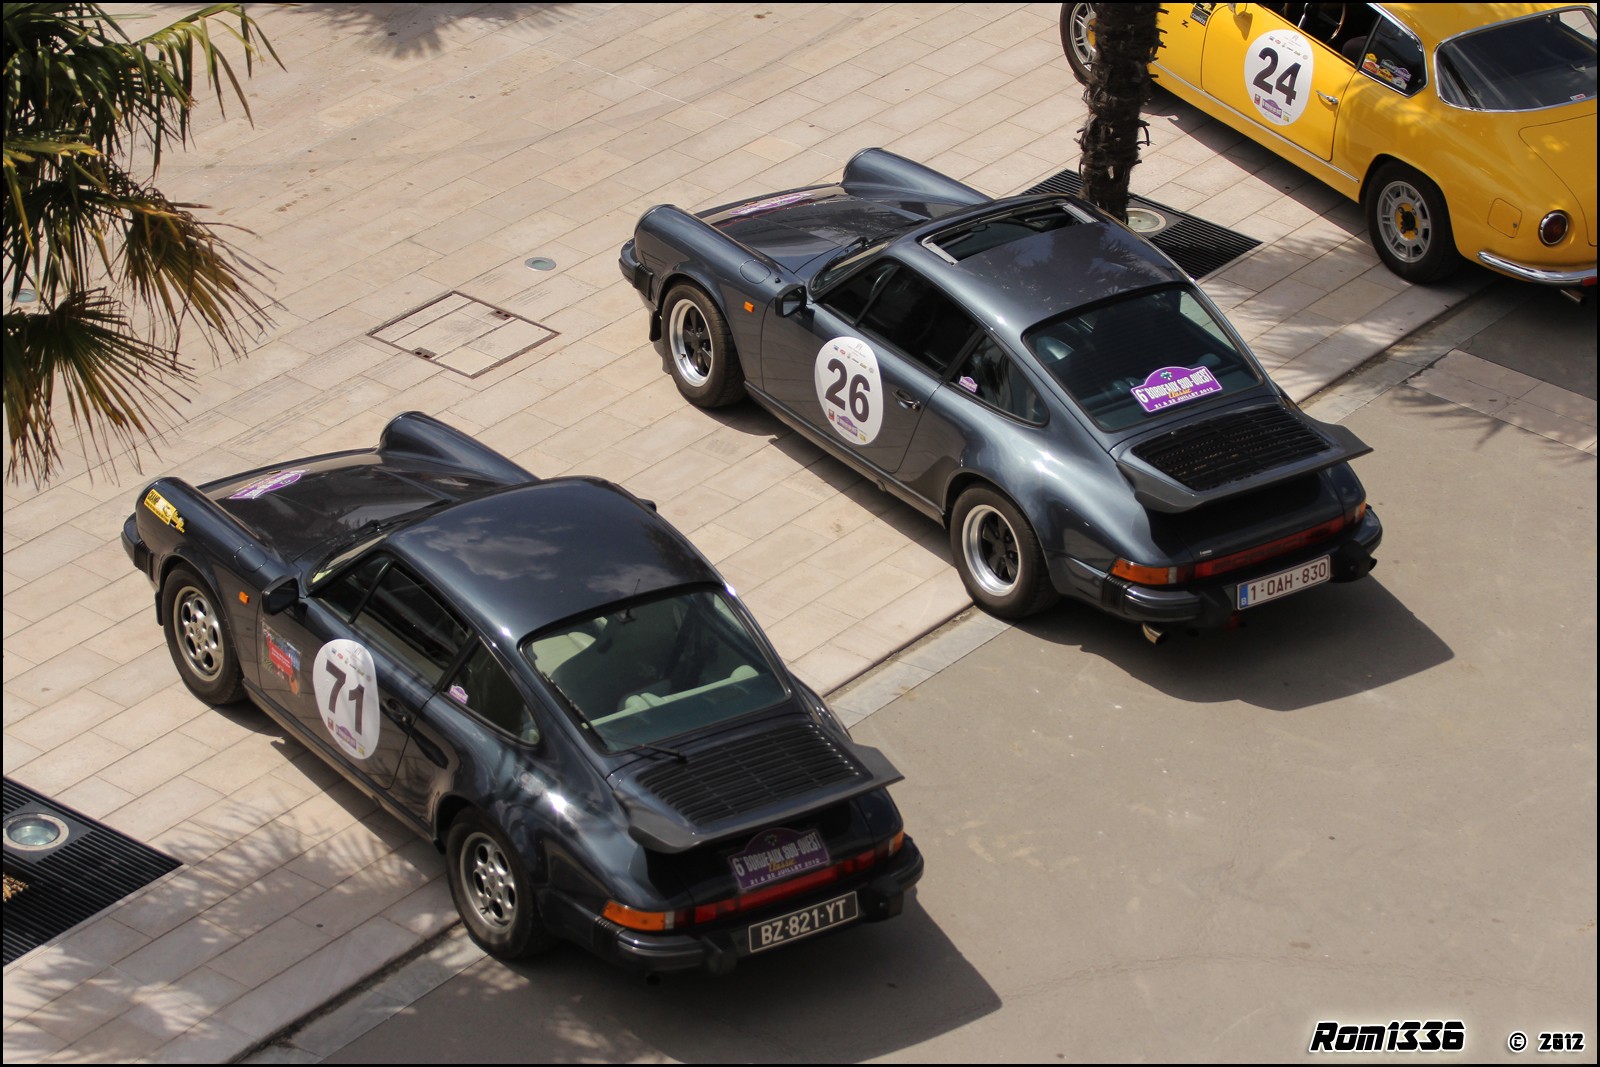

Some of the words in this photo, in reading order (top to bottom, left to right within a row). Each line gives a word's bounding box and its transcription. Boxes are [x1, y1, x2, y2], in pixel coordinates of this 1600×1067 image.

[1252, 46, 1302, 106] 24
[825, 358, 871, 423] 26
[1145, 381, 1181, 400] BORDEAUX
[1177, 368, 1214, 390] SUD-OUEST
[325, 659, 365, 736] 71
[743, 847, 785, 873] BORDEAUX
[782, 832, 822, 859] SUD-OUEST
[777, 863, 802, 876] JUILLET
[804, 858, 821, 867] 2012
